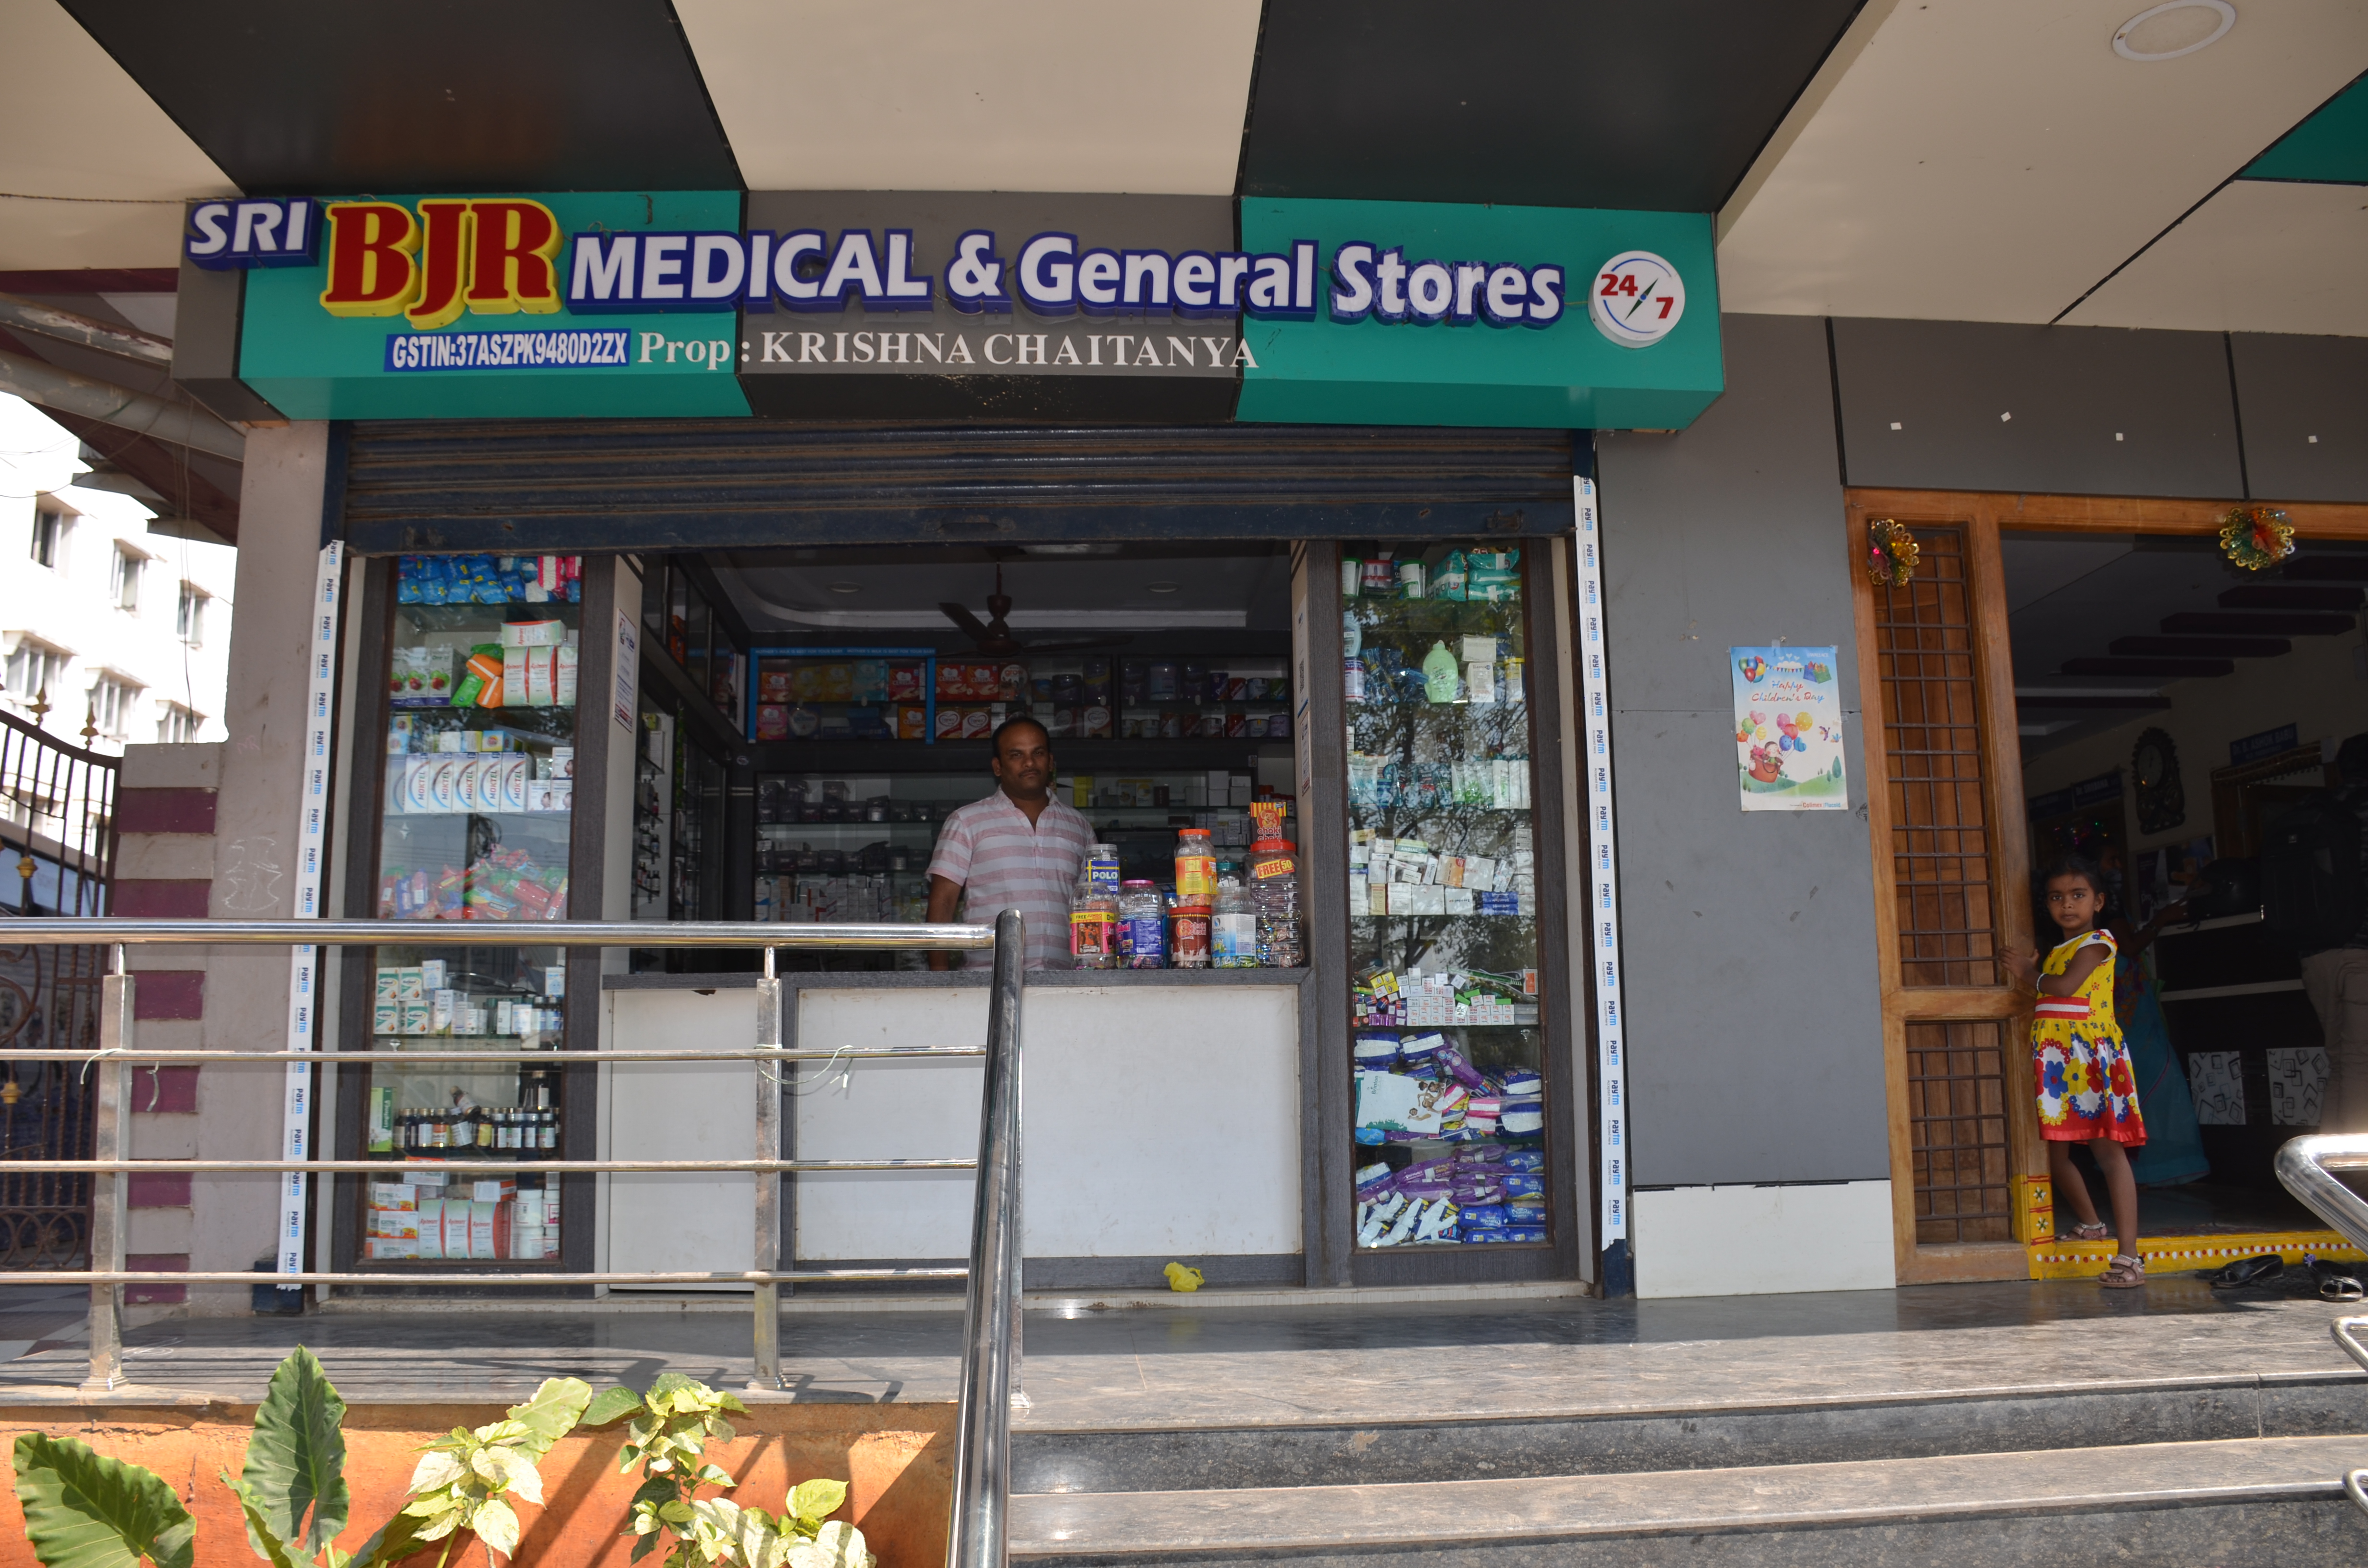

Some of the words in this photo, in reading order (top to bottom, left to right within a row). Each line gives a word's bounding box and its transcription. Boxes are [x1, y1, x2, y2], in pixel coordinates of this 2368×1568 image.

[186, 198, 312, 263] SRI
[320, 198, 562, 329] BJR
[569, 231, 932, 307] MEDICAL
[946, 232, 1009, 310] &
[1017, 233, 1318, 315] General
[1331, 241, 1565, 324] Stores
[1601, 274, 1638, 296] 24
[1655, 296, 1675, 319] 7
[761, 331, 976, 364] KRISHNA
[984, 334, 1259, 368] CHAITANYA
[1772, 680, 1803, 692] Happy
[1751, 692, 1801, 701] Children's
[1804, 691, 1825, 703] Day
[1258, 826, 1282, 834] choki
[1092, 871, 1118, 880] POLO
[1258, 862, 1280, 877] FREE
[1281, 859, 1292, 869] 50
